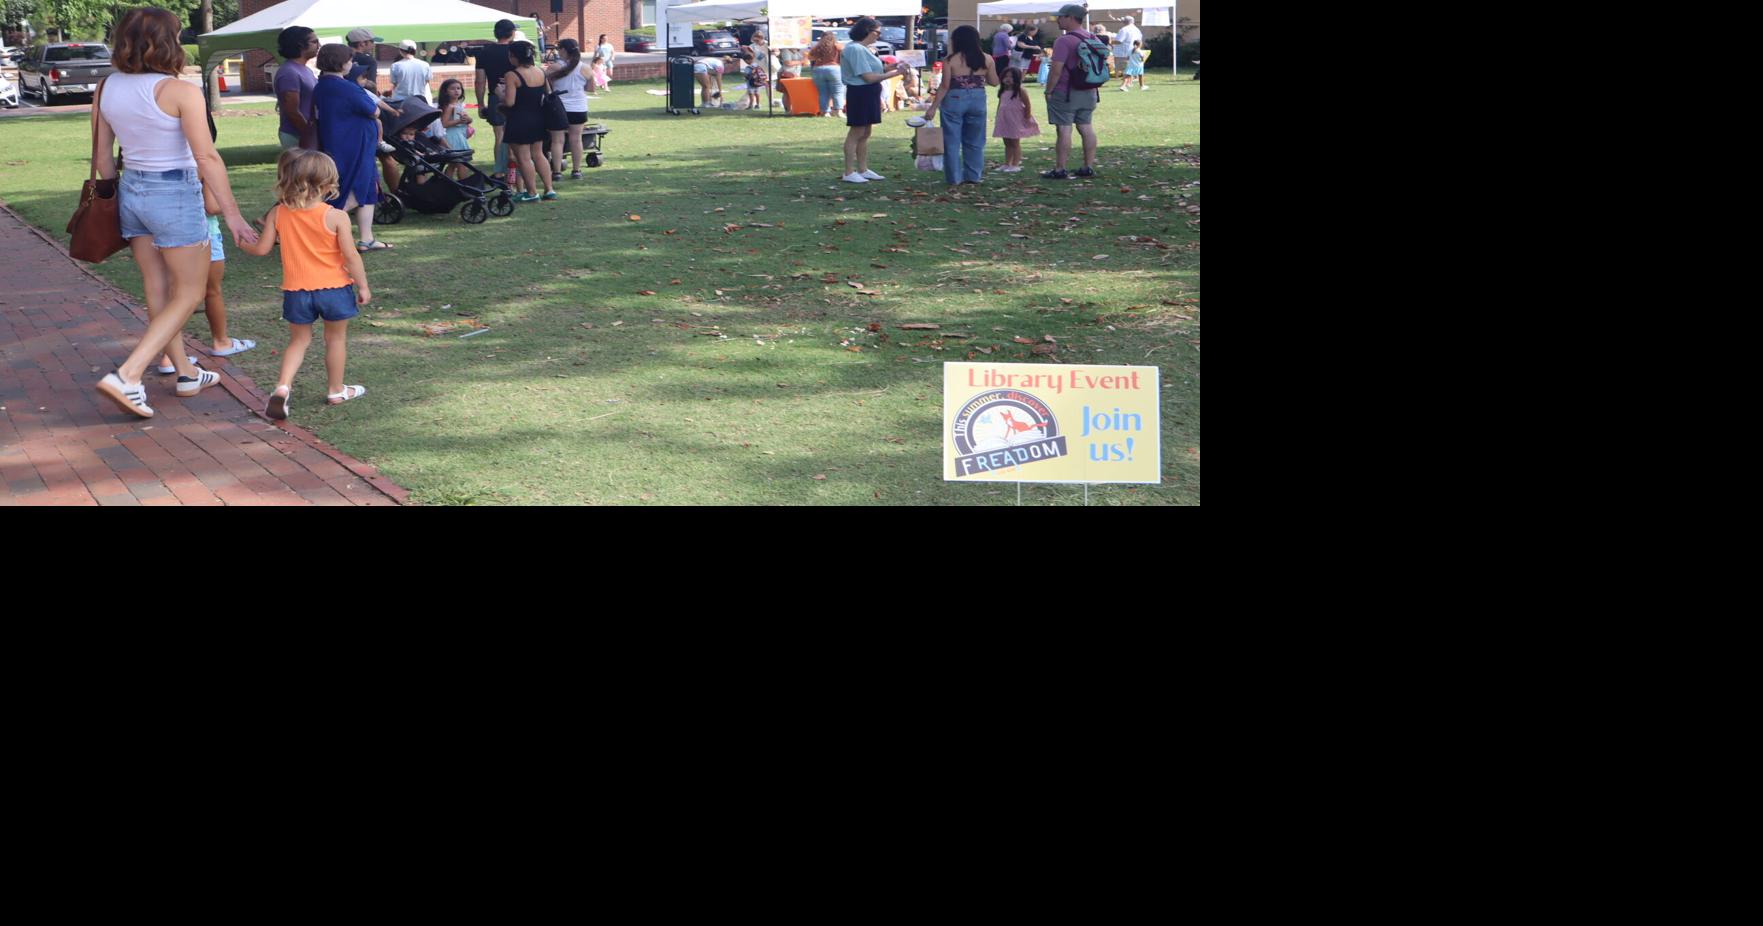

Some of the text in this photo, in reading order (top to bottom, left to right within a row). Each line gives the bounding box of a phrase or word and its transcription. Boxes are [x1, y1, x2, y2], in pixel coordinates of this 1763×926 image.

[968, 368, 1140, 394] Library Event
[1007, 391, 1050, 417] discover
[1081, 405, 1142, 437] Join
[961, 440, 1060, 475] FREADOM
[1089, 437, 1134, 462] us!
